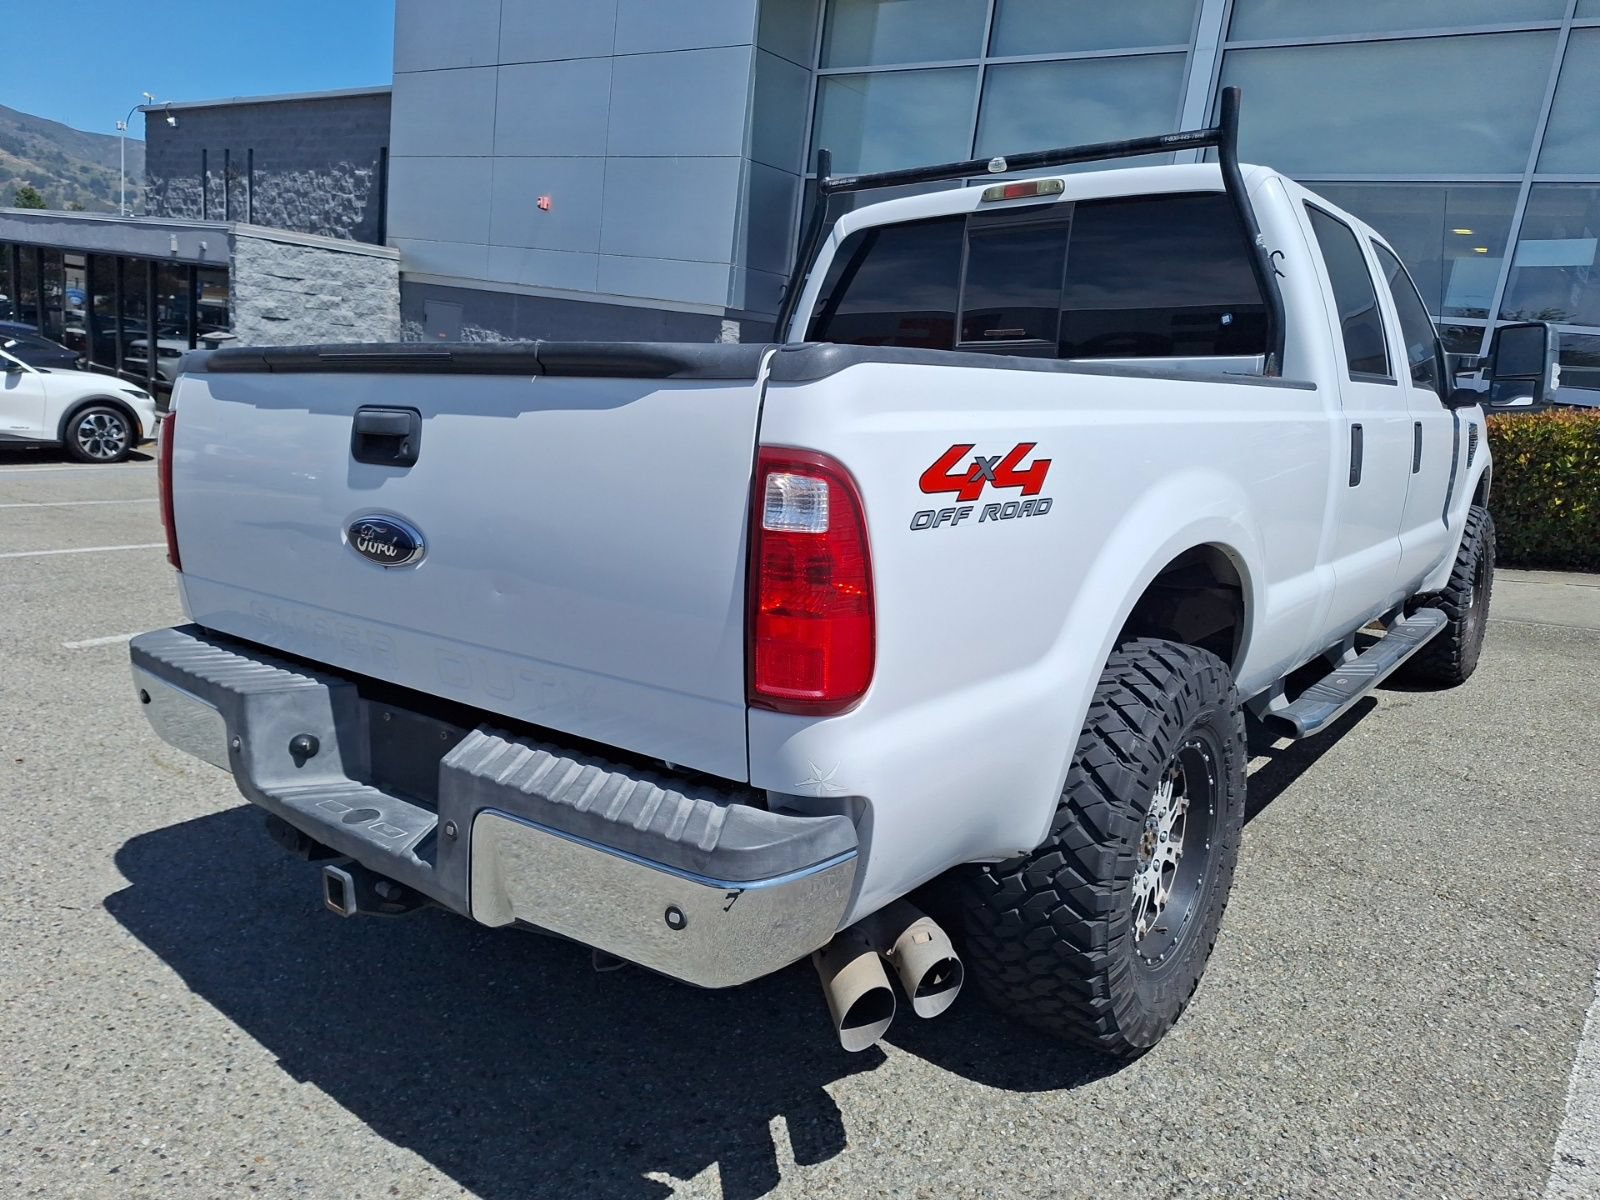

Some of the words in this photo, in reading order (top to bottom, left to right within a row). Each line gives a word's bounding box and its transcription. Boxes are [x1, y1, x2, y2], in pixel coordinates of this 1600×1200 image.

[910, 506, 974, 531] OFF
[978, 497, 1053, 523] ROAD
[357, 523, 399, 557] Ford
